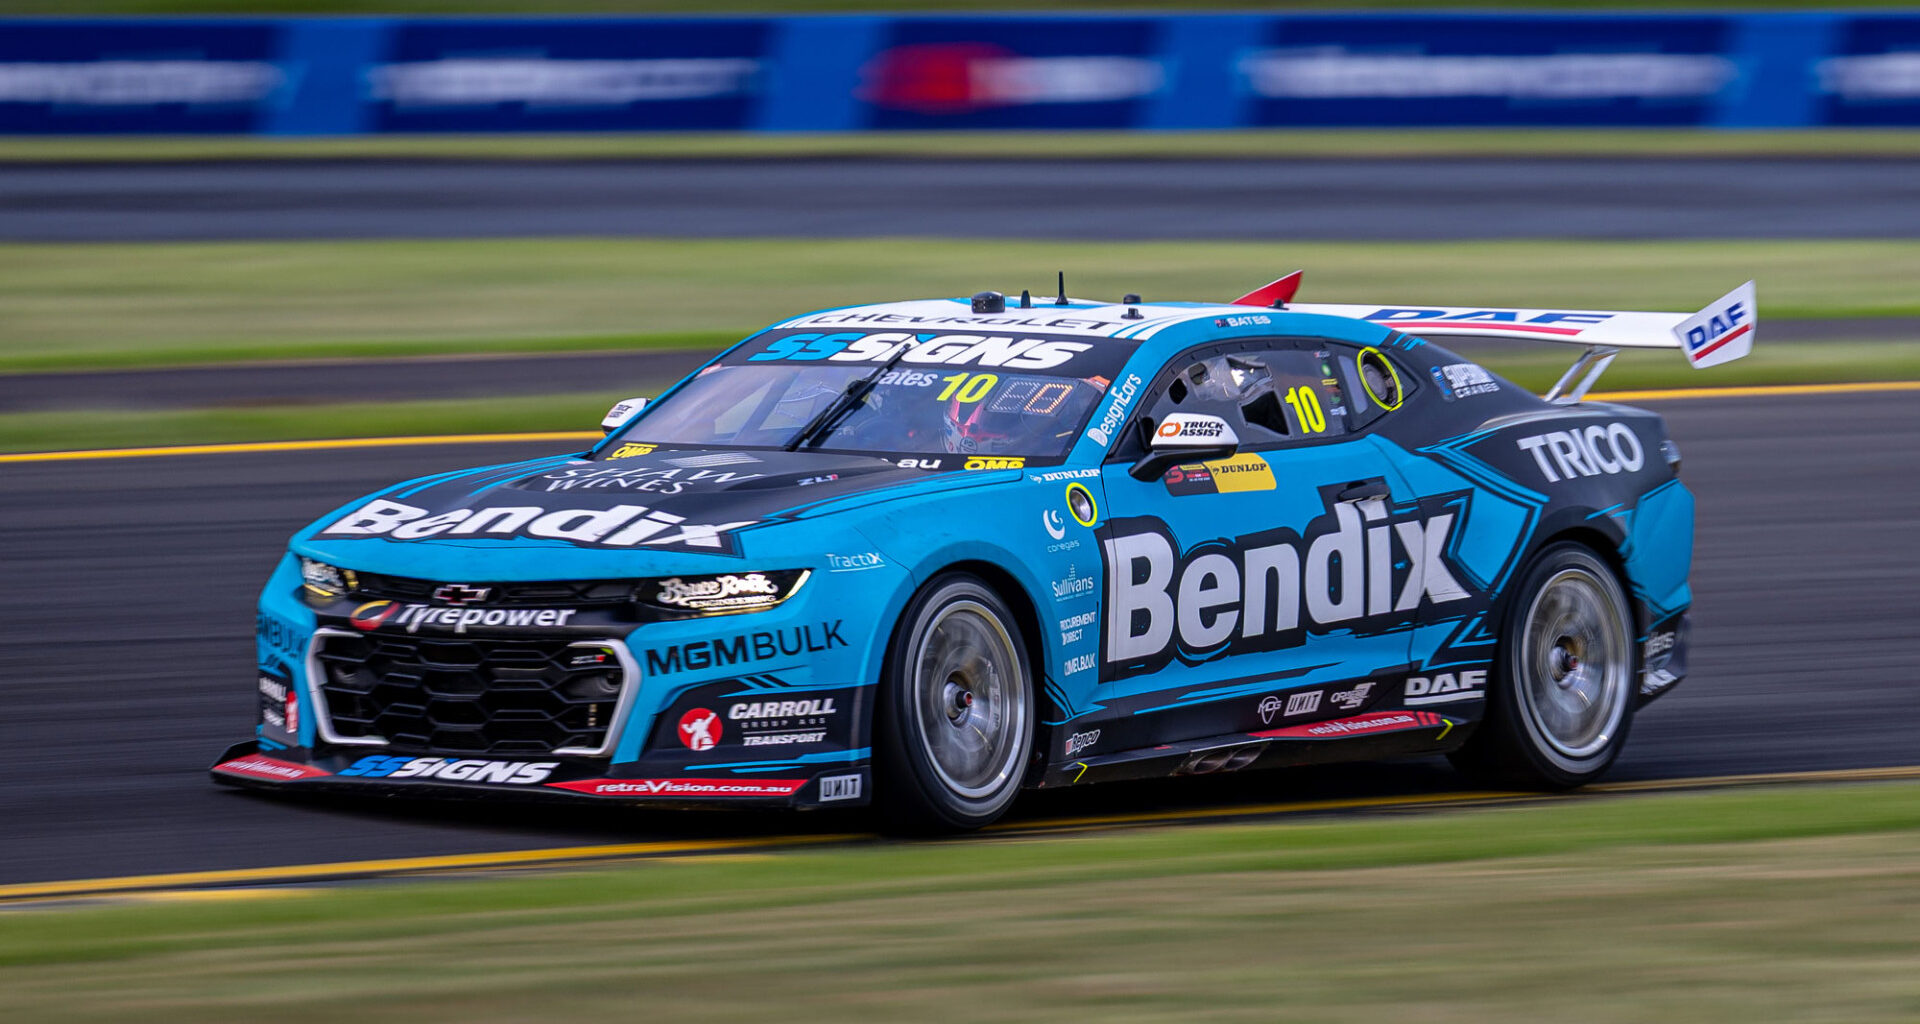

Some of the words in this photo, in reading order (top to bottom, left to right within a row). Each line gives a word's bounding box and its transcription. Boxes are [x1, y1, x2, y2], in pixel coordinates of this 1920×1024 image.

[809, 313, 1122, 330] CHEVROLET
[1227, 315, 1271, 327] BATES
[1364, 308, 1616, 323] DAF
[1686, 301, 1748, 351] DAF
[937, 372, 998, 403] 10
[1087, 374, 1141, 447] DesignEars
[1284, 385, 1326, 433] 10
[1180, 429, 1222, 437] ASSIST
[1184, 421, 1224, 429] TRUCK
[1516, 422, 1644, 483] TRICO
[543, 467, 767, 484] SHAW
[1042, 468, 1101, 481] DUNLOP
[1221, 463, 1267, 474] DUNLOP
[545, 477, 694, 494] WINES
[322, 498, 760, 548] Bendix
[1051, 576, 1094, 597] Sullivans
[1104, 499, 1472, 663] Bendix
[396, 603, 576, 633] Tyrepower
[1403, 670, 1487, 696] DAF
[728, 698, 836, 719] CARROLL
[743, 732, 827, 746] TRANSPORT
[823, 778, 859, 798] UNIT
